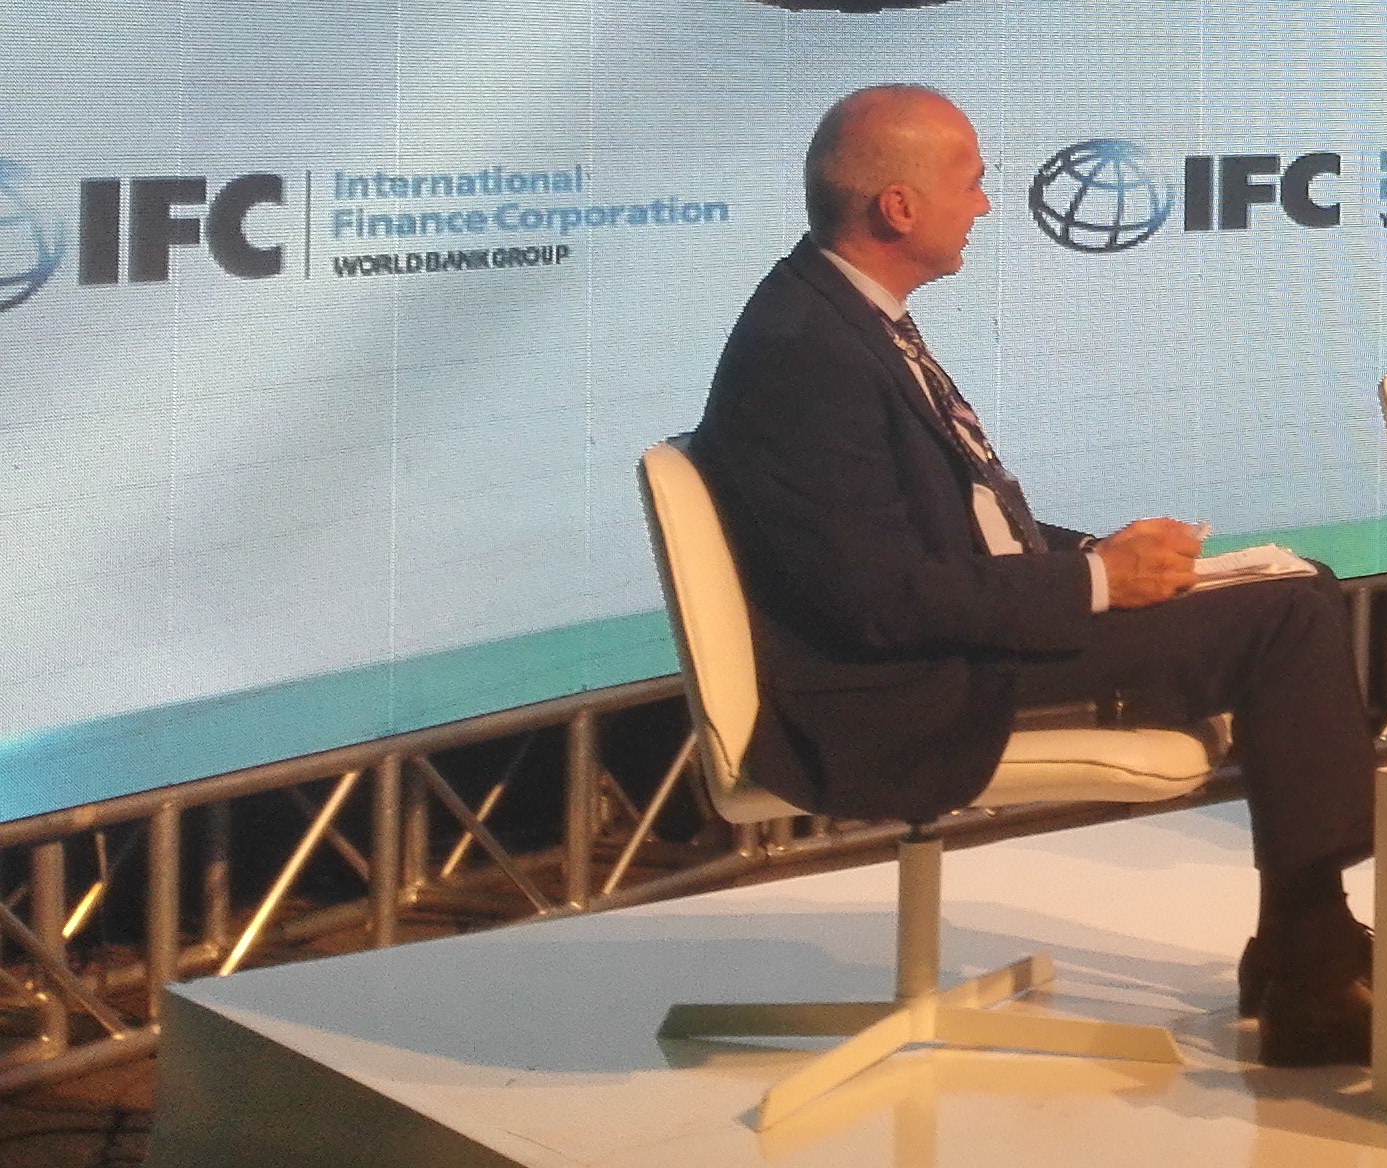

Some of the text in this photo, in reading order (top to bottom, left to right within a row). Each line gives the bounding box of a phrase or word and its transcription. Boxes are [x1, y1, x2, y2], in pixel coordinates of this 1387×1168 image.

[333, 163, 584, 201] International
[1184, 152, 1341, 231] IFC
[78, 172, 285, 286] IFC
[332, 198, 731, 240] Finance Corporation
[333, 245, 571, 279] WORLD BANK GROUP
